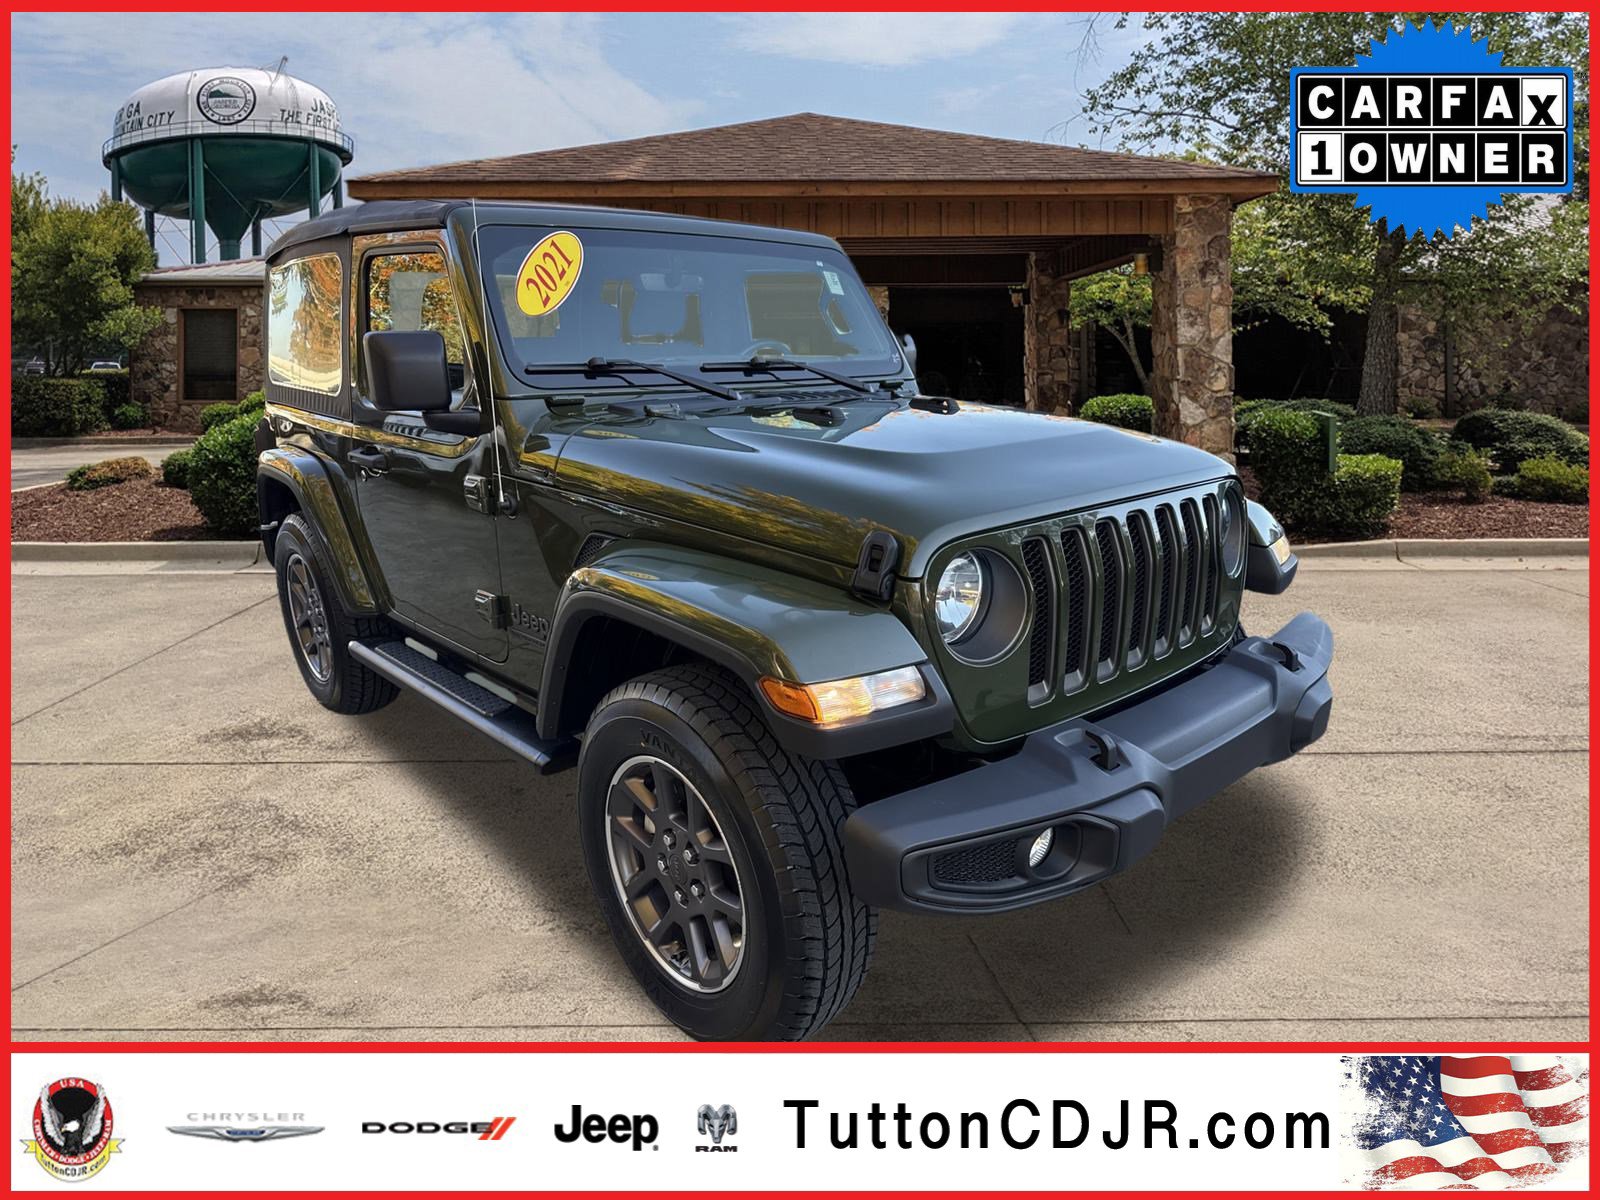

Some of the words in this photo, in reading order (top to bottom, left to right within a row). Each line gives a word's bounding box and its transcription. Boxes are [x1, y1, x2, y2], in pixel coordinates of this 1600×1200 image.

[126, 100, 141, 119] GA
[147, 110, 175, 127] CITY
[280, 109, 302, 123] THE
[526, 239, 574, 309] 2021
[511, 602, 550, 639] Jeep
